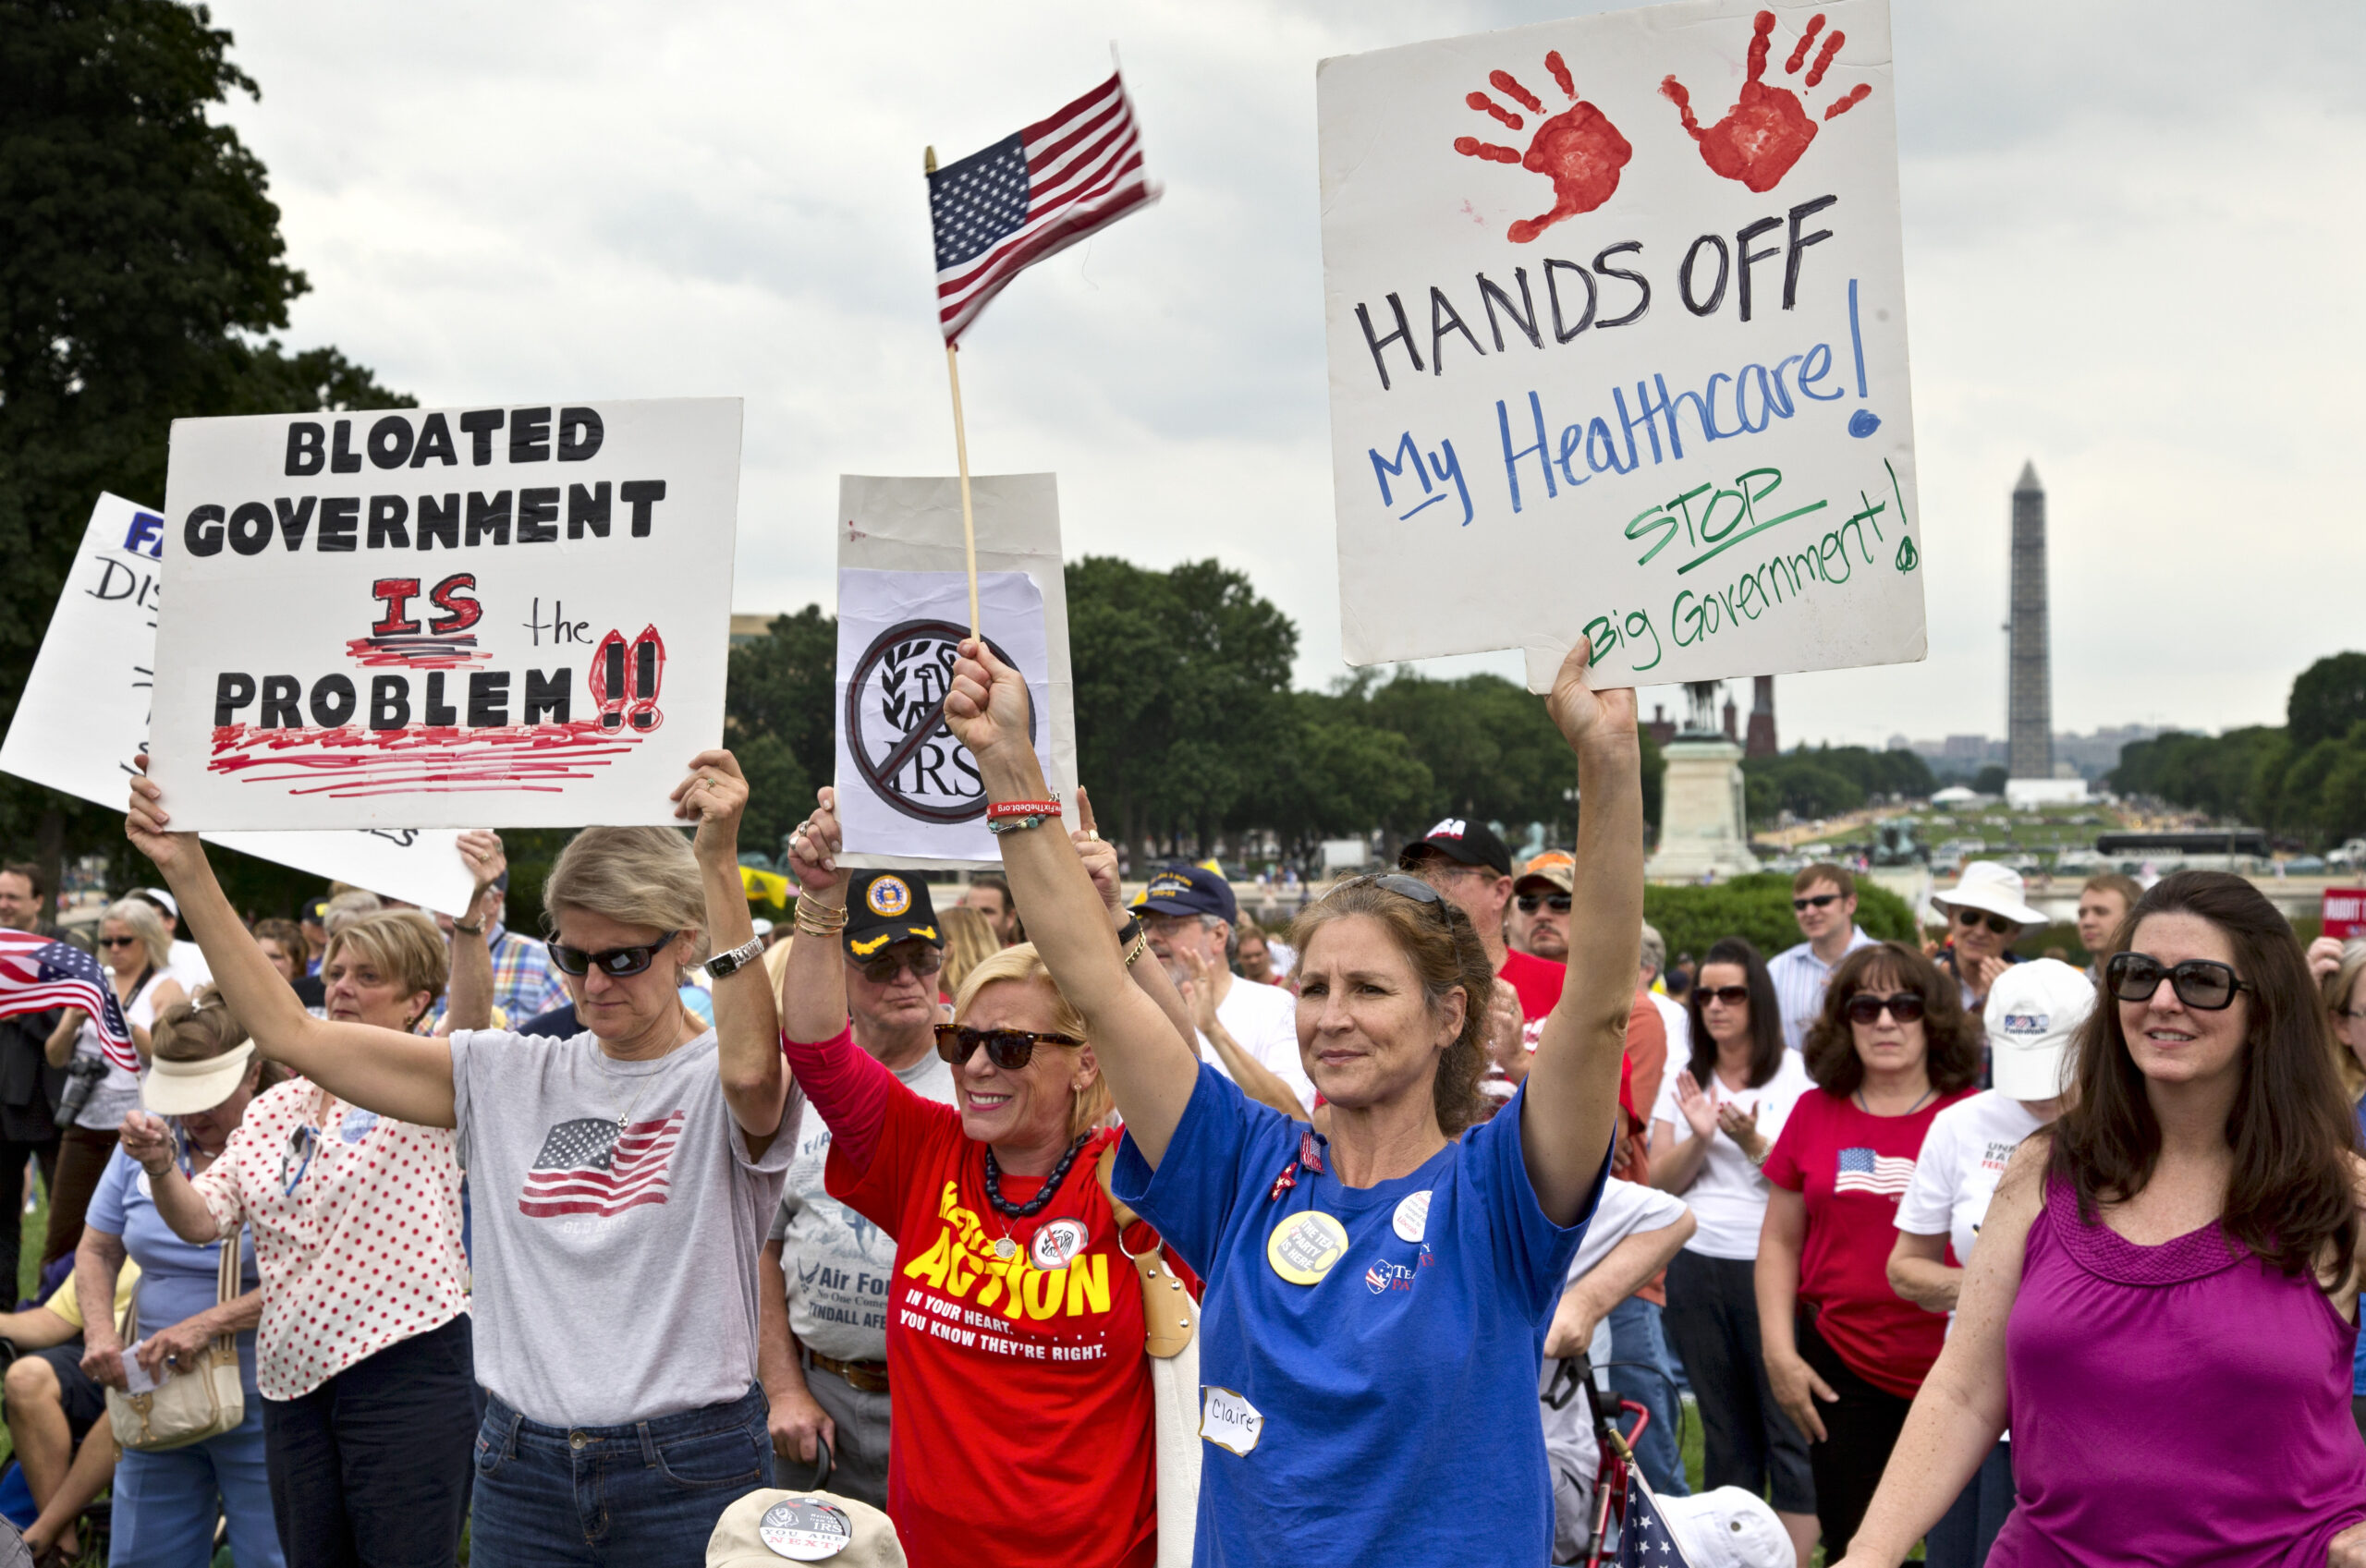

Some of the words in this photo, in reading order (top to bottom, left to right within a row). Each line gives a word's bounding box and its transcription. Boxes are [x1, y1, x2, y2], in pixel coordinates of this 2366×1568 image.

[1355, 240, 1650, 391] HANDS
[1678, 194, 1838, 322] OFF
[1369, 431, 1473, 527] My
[1495, 279, 1881, 513] Healthcare!
[286, 407, 604, 477] BLOATED
[185, 480, 666, 557] GOVERNMENT
[1624, 468, 1782, 566] STOP
[1582, 608, 1662, 671] Big
[1671, 457, 1918, 648] Government!
[372, 573, 483, 638] IS
[523, 598, 594, 647] the
[884, 740, 987, 798] IRS
[1281, 1239, 1292, 1251] IS
[1287, 1248, 1314, 1269] HERE
[1293, 1233, 1322, 1257] PARTY
[1301, 1220, 1319, 1238] THE
[1315, 1234, 1334, 1249] TEA
[819, 1267, 850, 1291] Air
[903, 1226, 1111, 1320] ACTION
[905, 1288, 923, 1307] IN
[921, 1294, 962, 1320] YOUR
[899, 1309, 926, 1331] YOU
[930, 1321, 976, 1346] KNOW
[981, 1335, 1045, 1359] THEY'RE
[1053, 1344, 1107, 1361] RIGHT.
[1212, 1398, 1255, 1432] Claire
[769, 1537, 842, 1552] NEXT!
[810, 1533, 843, 1541] ARE
[813, 1522, 843, 1533] IRS
